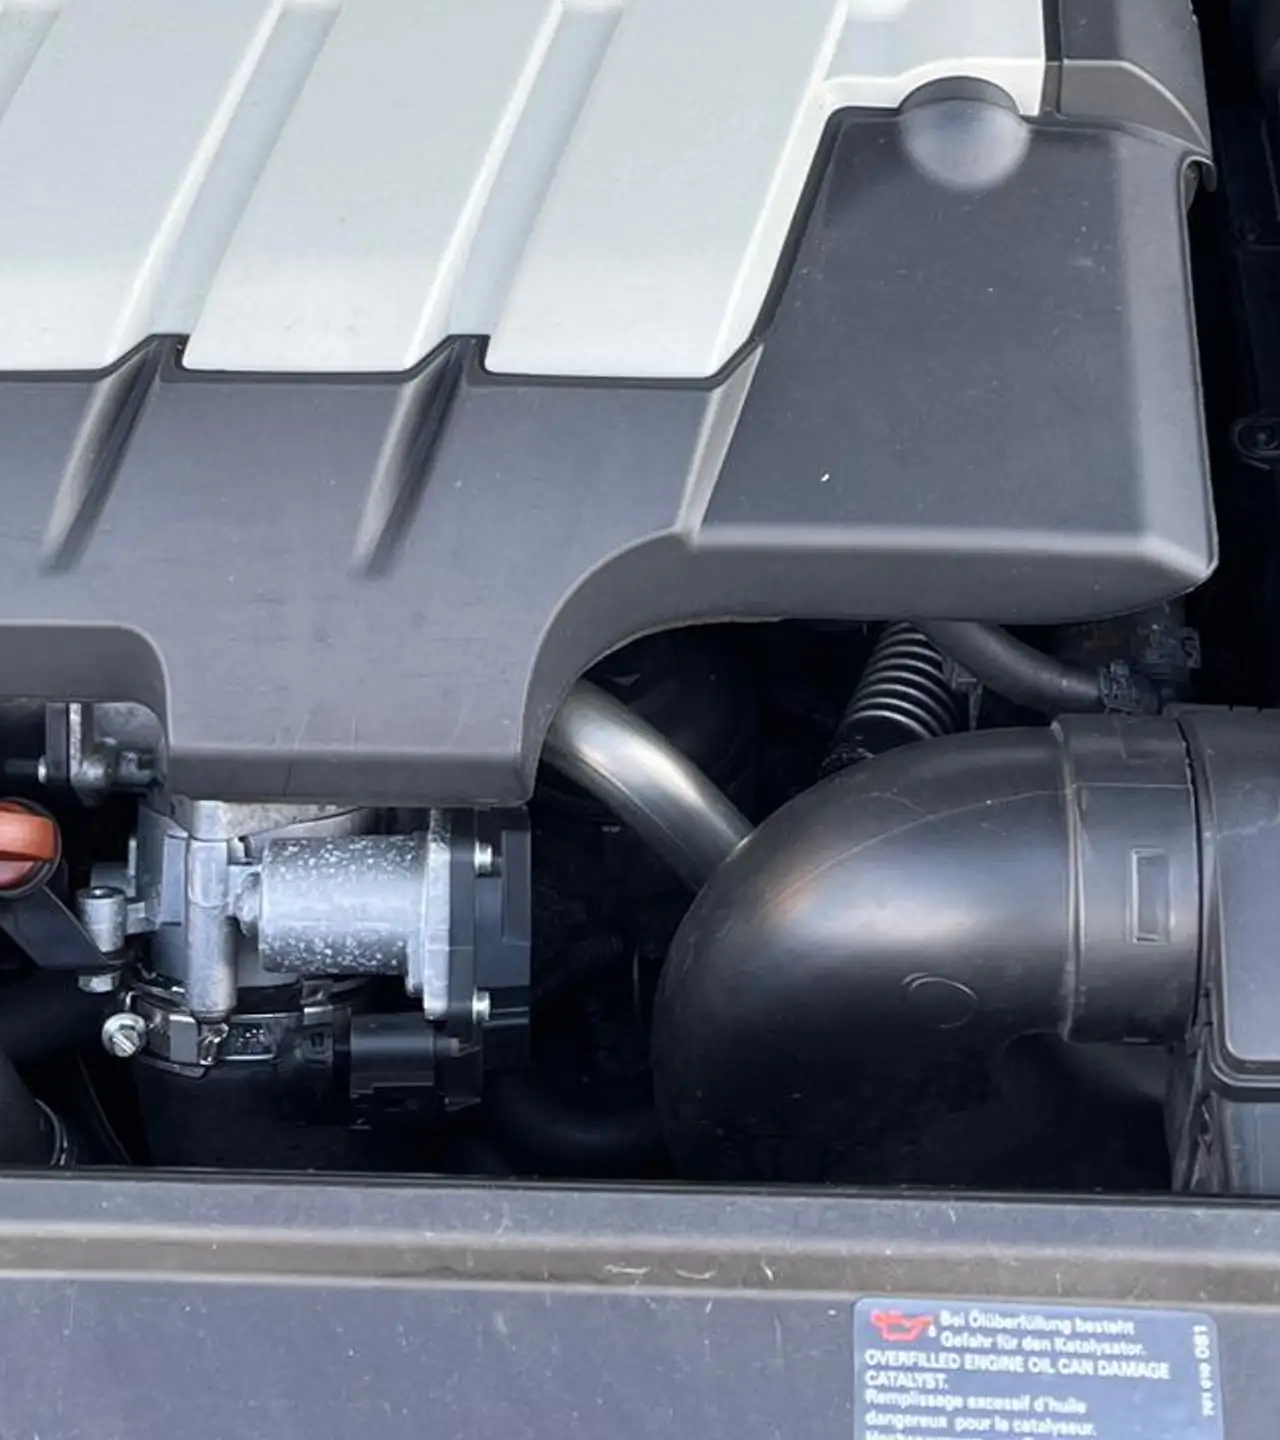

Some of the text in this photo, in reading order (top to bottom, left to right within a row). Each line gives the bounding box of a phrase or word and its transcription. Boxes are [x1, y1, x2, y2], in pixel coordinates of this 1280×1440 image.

[939, 1309, 1135, 1335] Bei Ölüberfüllung besteht
[939, 1330, 1148, 1357] Gefahr für den Katalysator.
[865, 1349, 1171, 1379] OVERFILLED ENGINE OIL CAN DAMAGE
[865, 1369, 949, 1390] CATALYST.
[865, 1388, 1087, 1415] Remplissage excessif d'huile
[865, 1410, 948, 1430] dangereux
[954, 1416, 991, 1433] pour
[1012, 1418, 1097, 1437] catalyseur.
